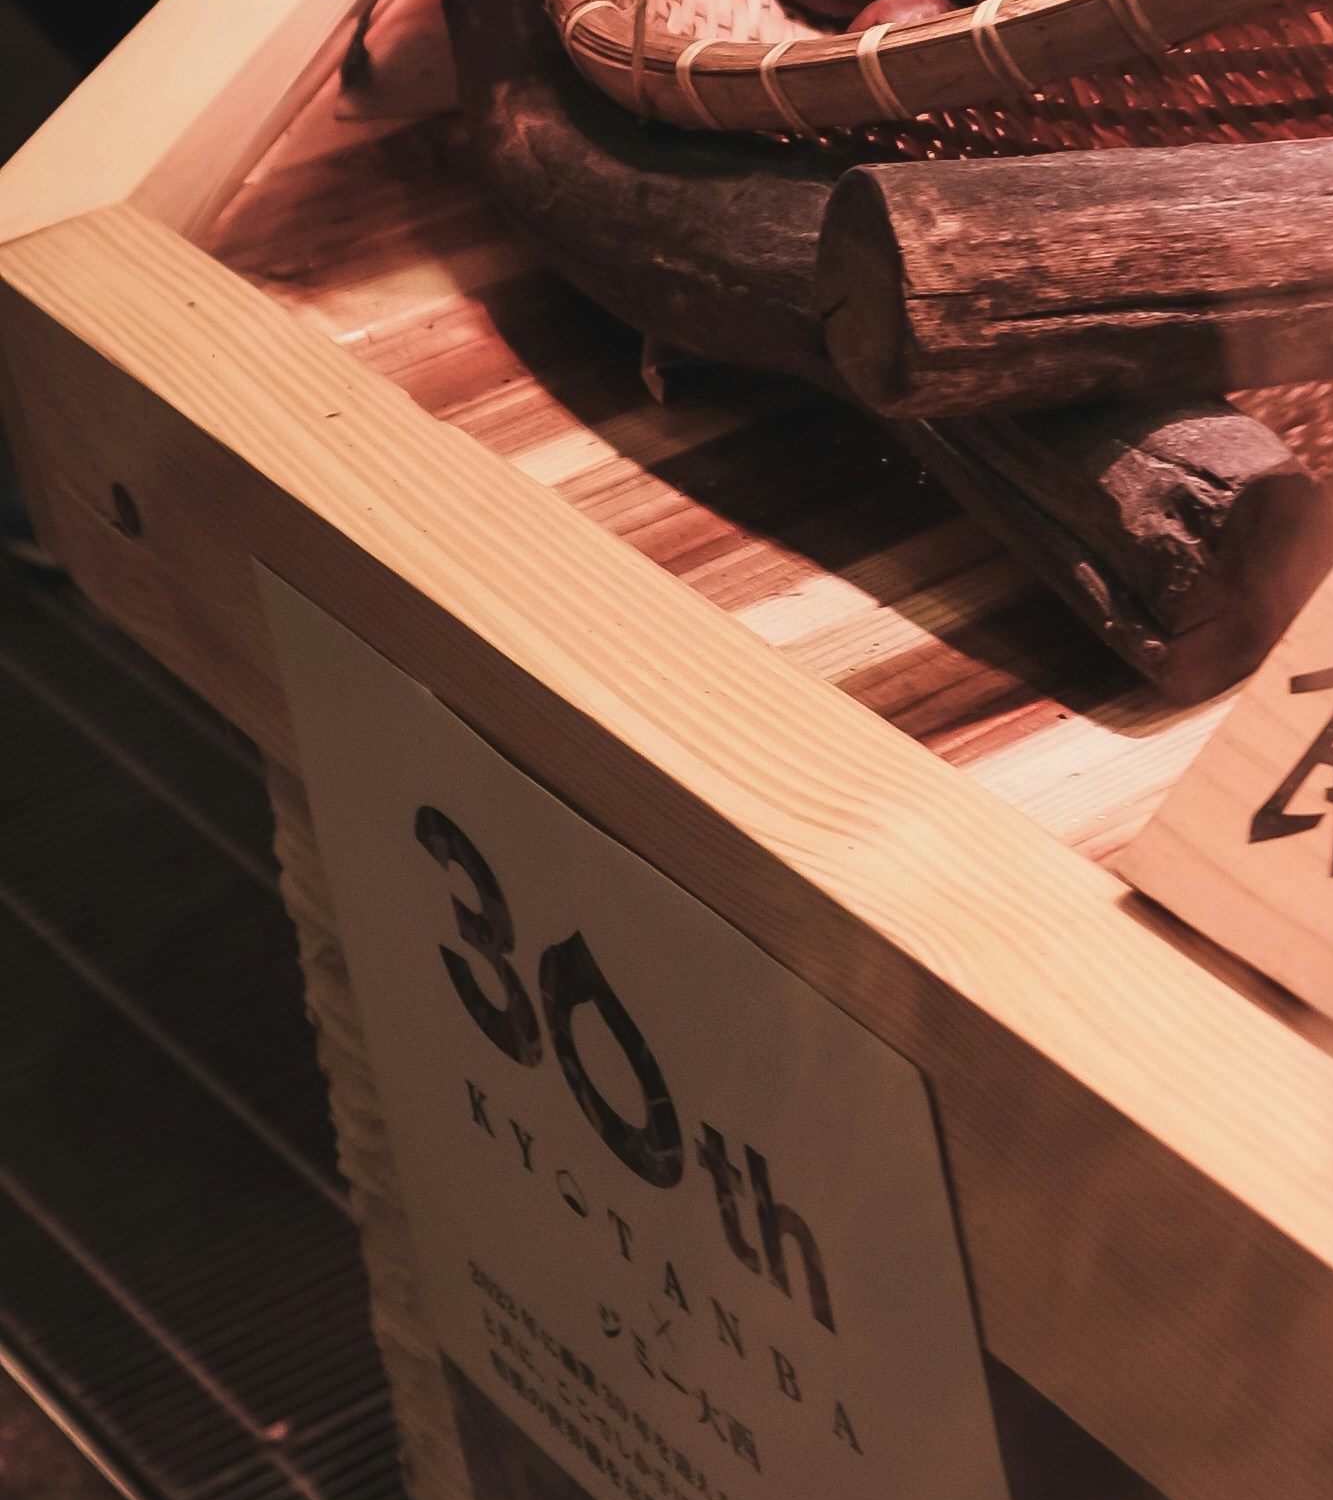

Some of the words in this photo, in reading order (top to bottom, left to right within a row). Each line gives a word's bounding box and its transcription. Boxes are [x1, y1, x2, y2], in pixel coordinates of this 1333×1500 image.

[414, 806, 835, 1332] 30th
[596, 1302, 762, 1474] ジミー大西
